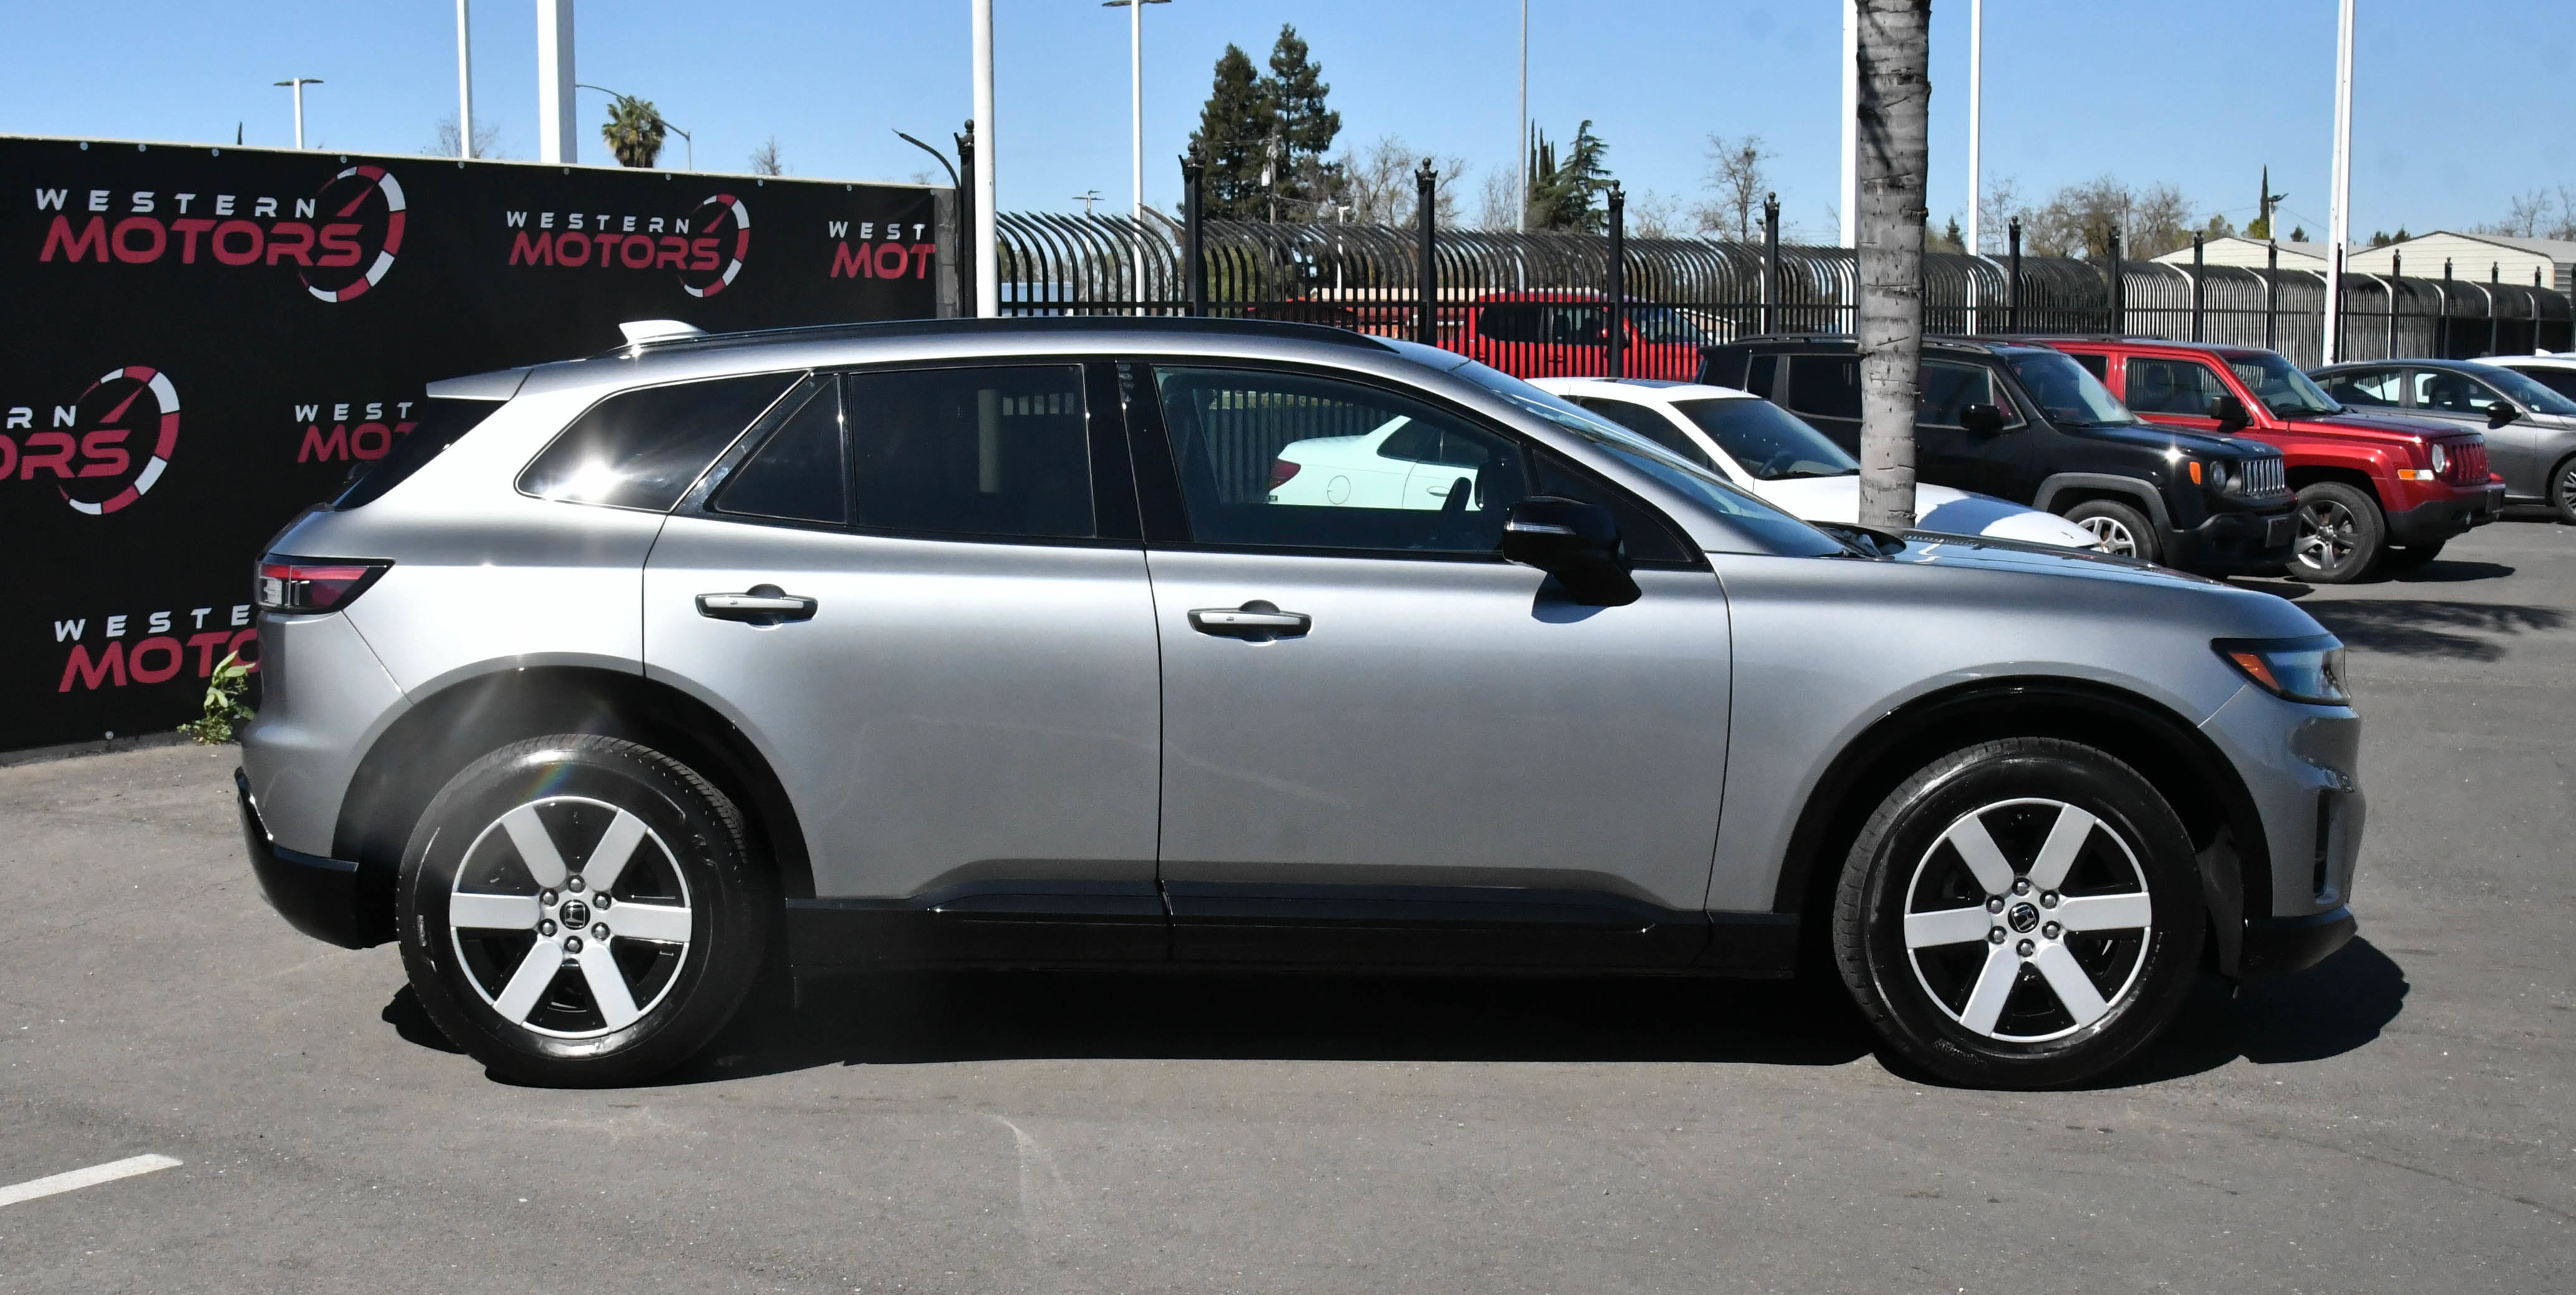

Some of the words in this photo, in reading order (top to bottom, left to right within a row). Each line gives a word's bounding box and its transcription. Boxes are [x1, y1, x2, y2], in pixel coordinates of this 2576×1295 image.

[36, 188, 315, 219] WESTERN
[507, 211, 690, 234] WESTERN
[39, 215, 363, 267] MOTORS
[509, 231, 720, 270] MOTORS
